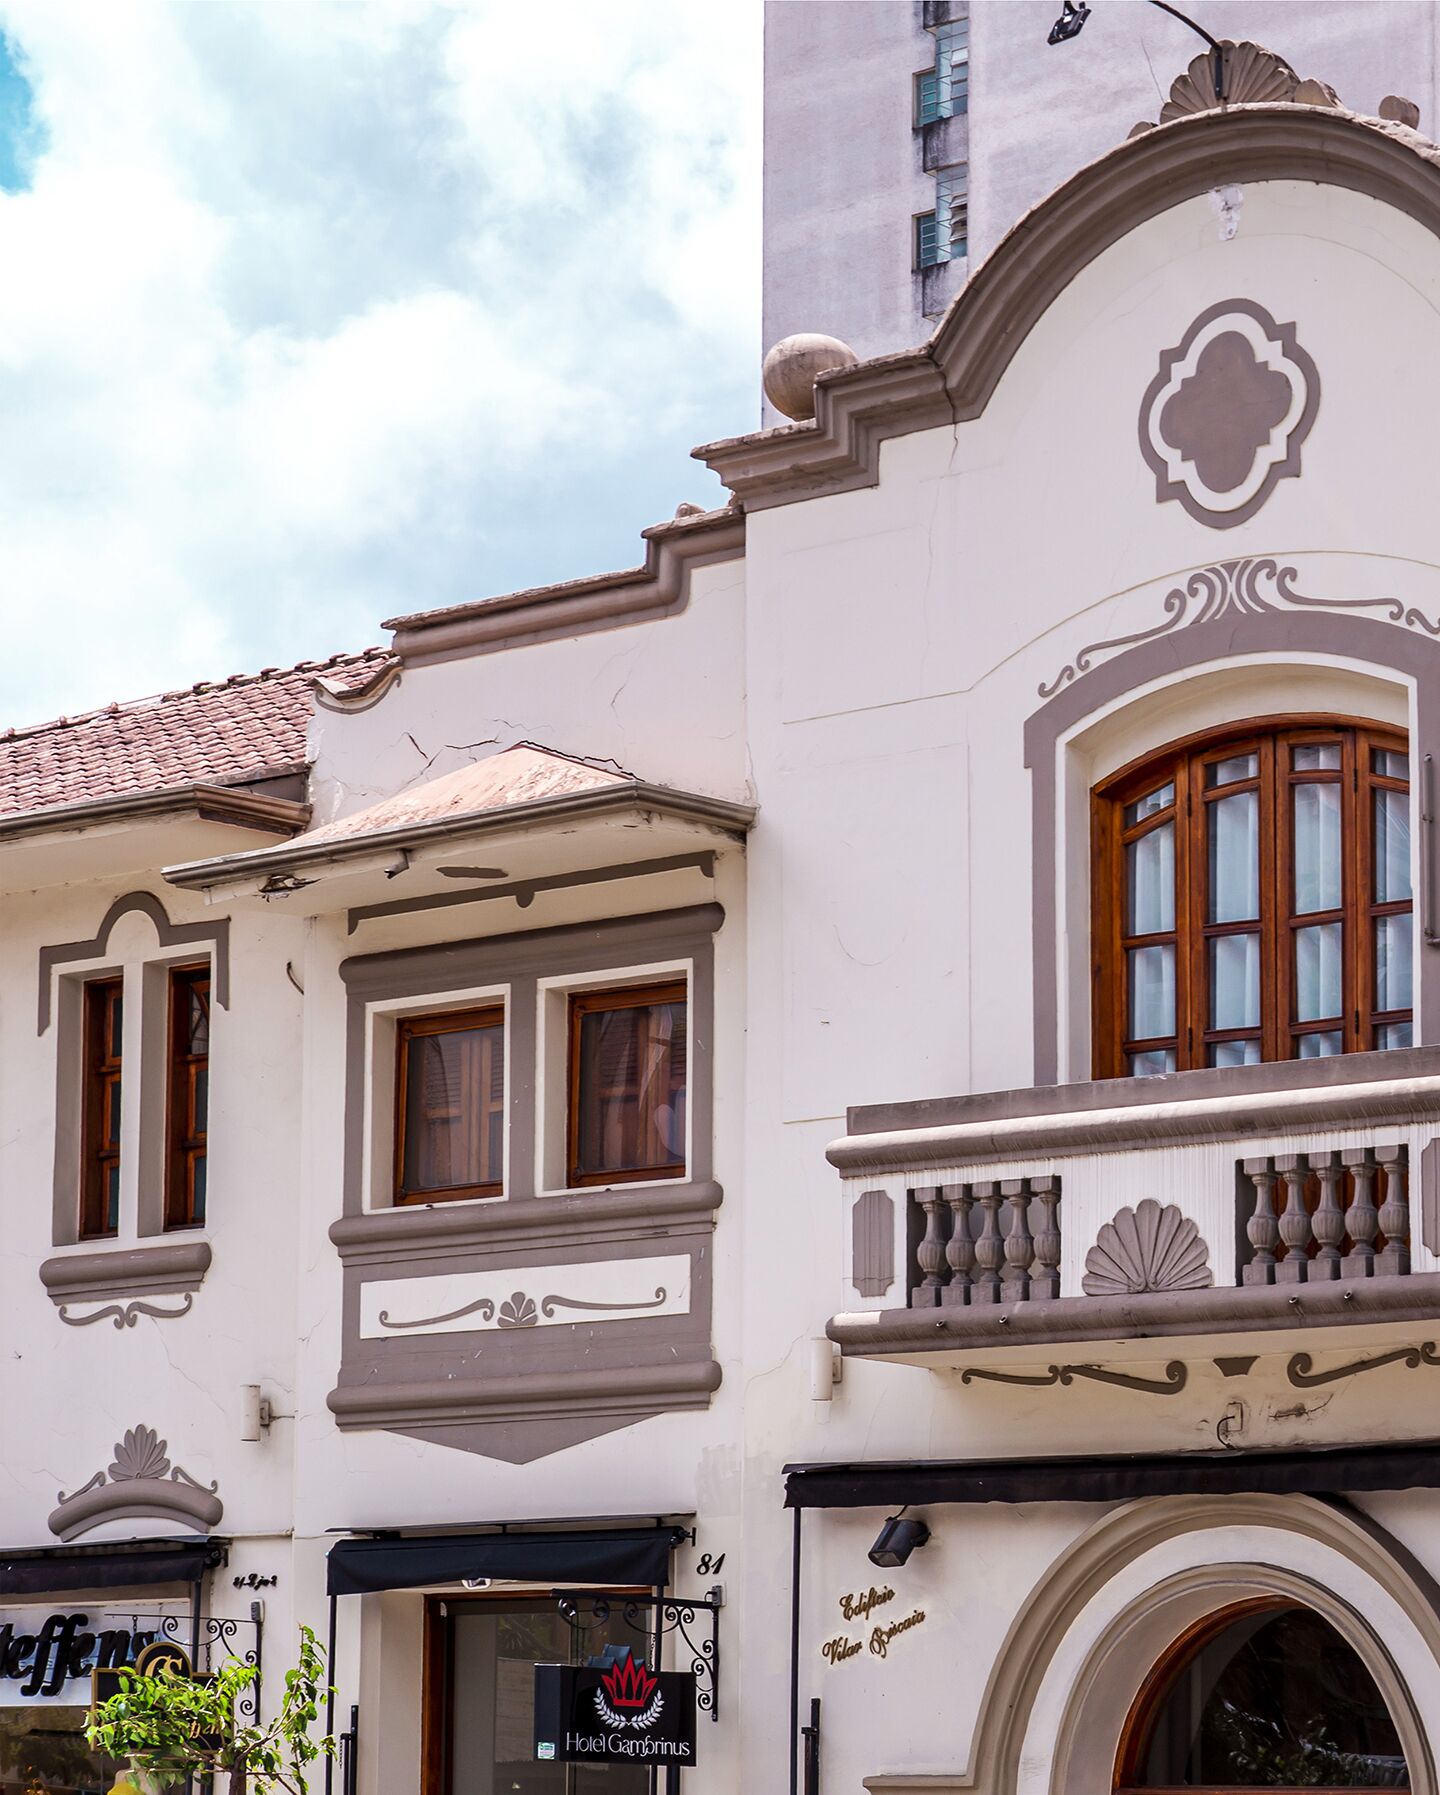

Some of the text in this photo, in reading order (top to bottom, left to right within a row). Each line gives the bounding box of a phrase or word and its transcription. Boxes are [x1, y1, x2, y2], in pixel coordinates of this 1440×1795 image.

[696, 1553, 725, 1575] 81
[822, 1636, 862, 1665] Vilar
[566, 1732, 605, 1752] Hotel
[608, 1733, 690, 1757] Gambrinus
